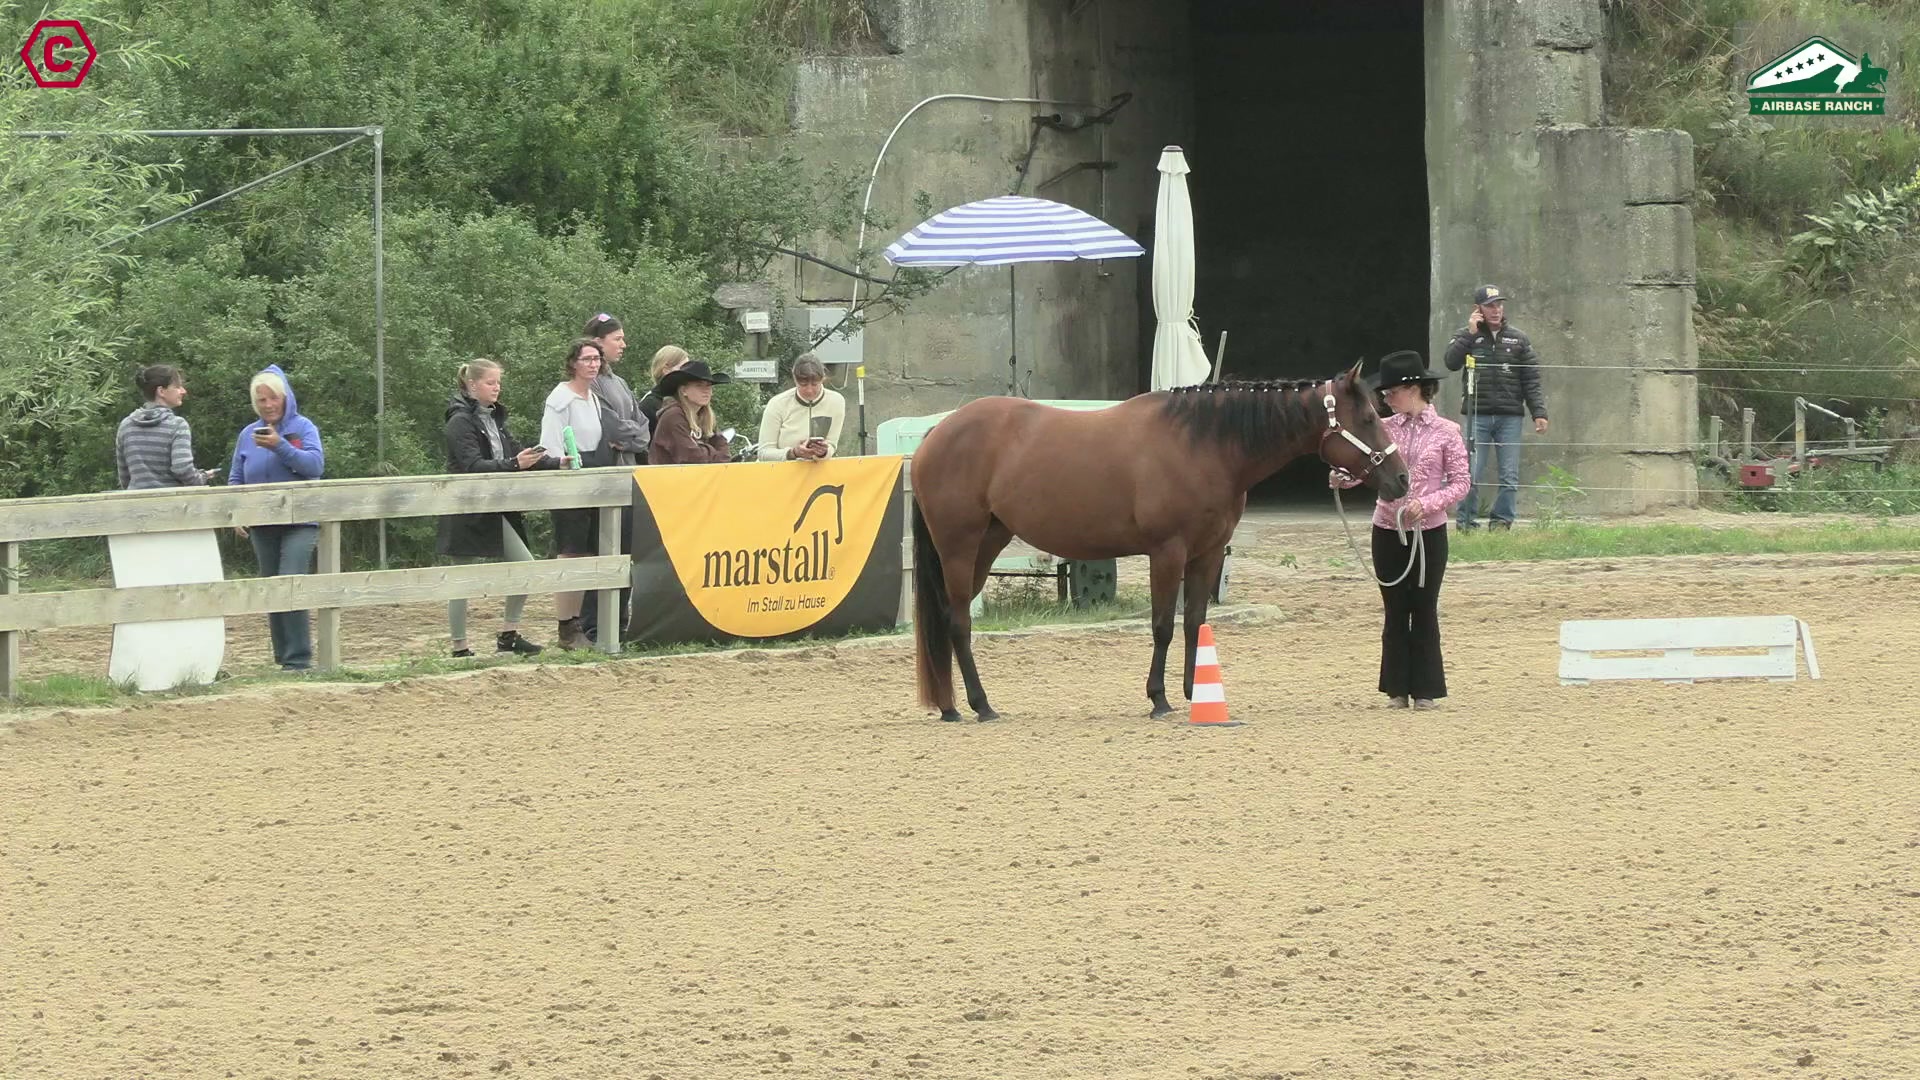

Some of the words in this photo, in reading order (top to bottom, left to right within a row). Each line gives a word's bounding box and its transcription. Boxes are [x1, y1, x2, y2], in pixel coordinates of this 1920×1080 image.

[702, 530, 830, 588] marstall
[747, 597, 760, 613] Im
[762, 595, 783, 612] Stall
[785, 599, 796, 611] zu
[798, 594, 826, 609] Hause
